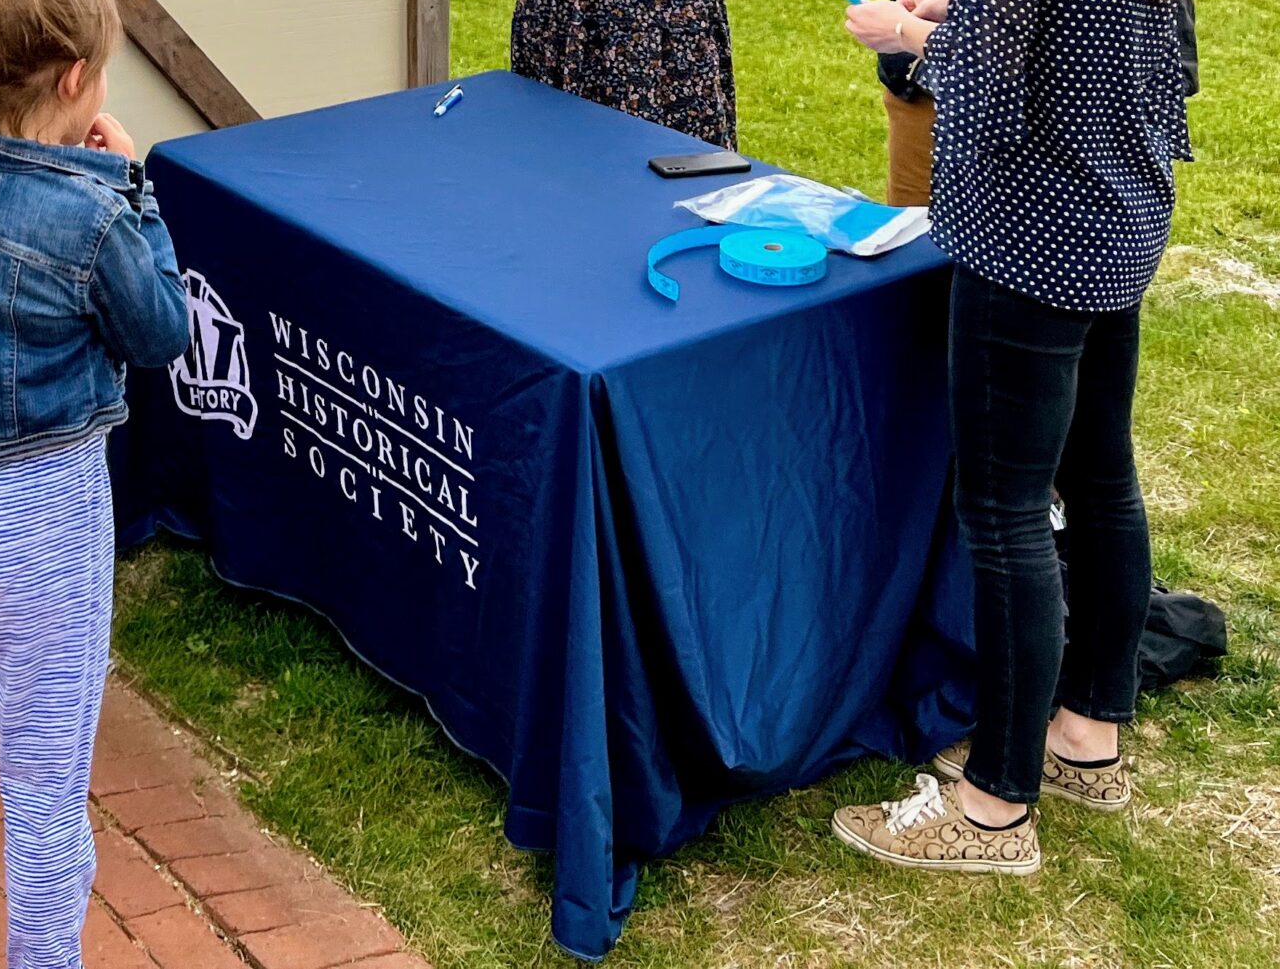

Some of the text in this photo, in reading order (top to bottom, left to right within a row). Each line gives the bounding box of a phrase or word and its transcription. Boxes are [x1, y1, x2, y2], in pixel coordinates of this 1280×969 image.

[269, 311, 474, 461] WISCONSIN
[276, 369, 478, 527] HISTORICAL
[283, 428, 480, 591] SOCIETY
